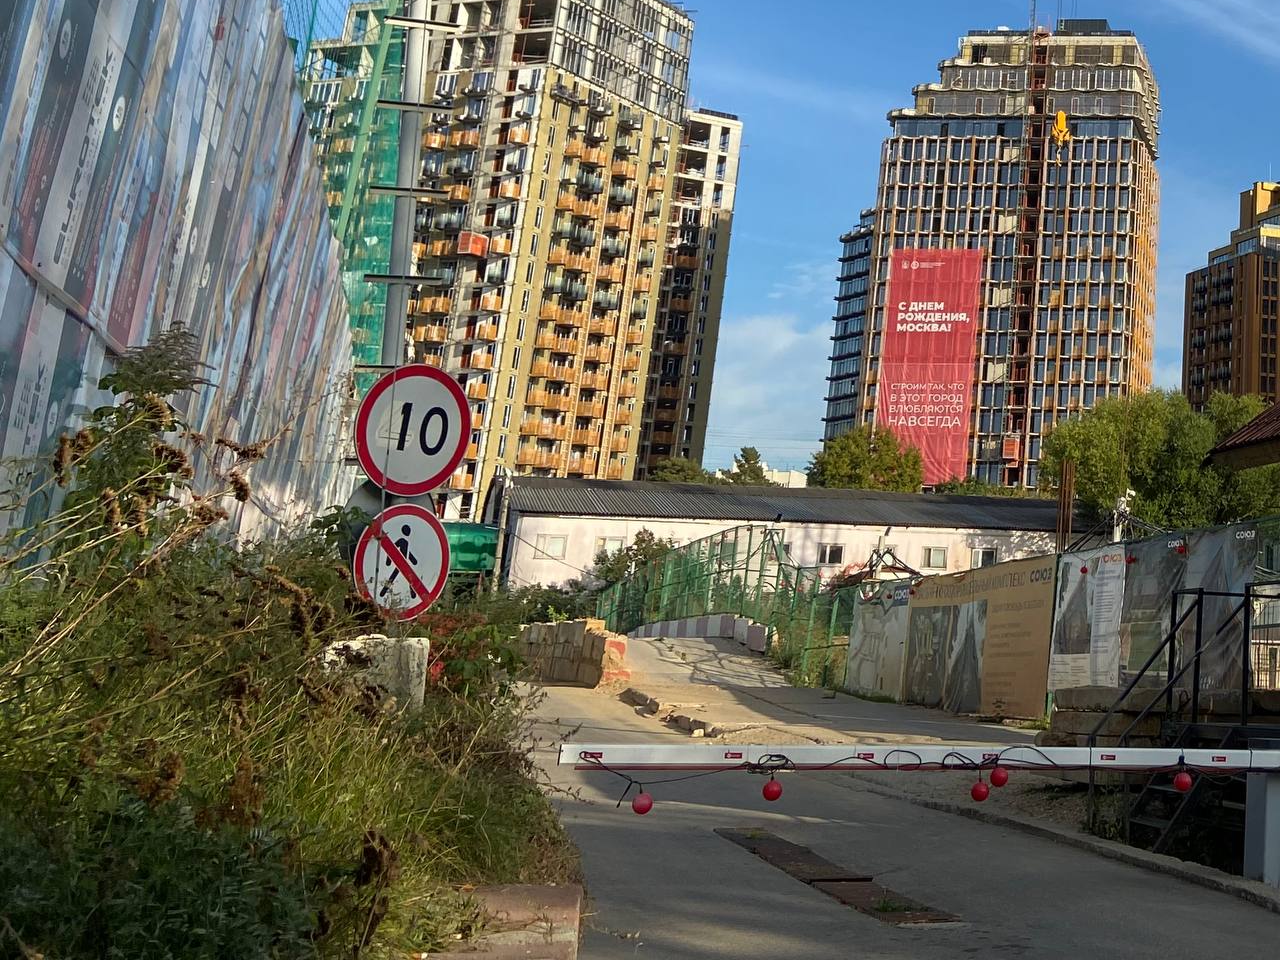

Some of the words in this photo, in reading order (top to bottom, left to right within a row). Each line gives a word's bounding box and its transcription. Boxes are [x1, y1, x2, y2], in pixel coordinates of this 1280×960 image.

[898, 302, 907, 311] С
[908, 302, 945, 312] ДНЕМ
[897, 312, 970, 323] РОЖДЕНИЯ,
[896, 323, 952, 332] МОСКВА!
[928, 383, 946, 391] ТАК,
[890, 393, 897, 402] В
[899, 393, 926, 402] ЭТОТ
[928, 393, 964, 403] ГОРОД
[889, 404, 963, 413] ВЛЮБЛЯЮТСЯ
[888, 415, 961, 429] НАВСЕГДА
[396, 402, 449, 457] 10
[1029, 567, 1053, 584] СОЮЗ
